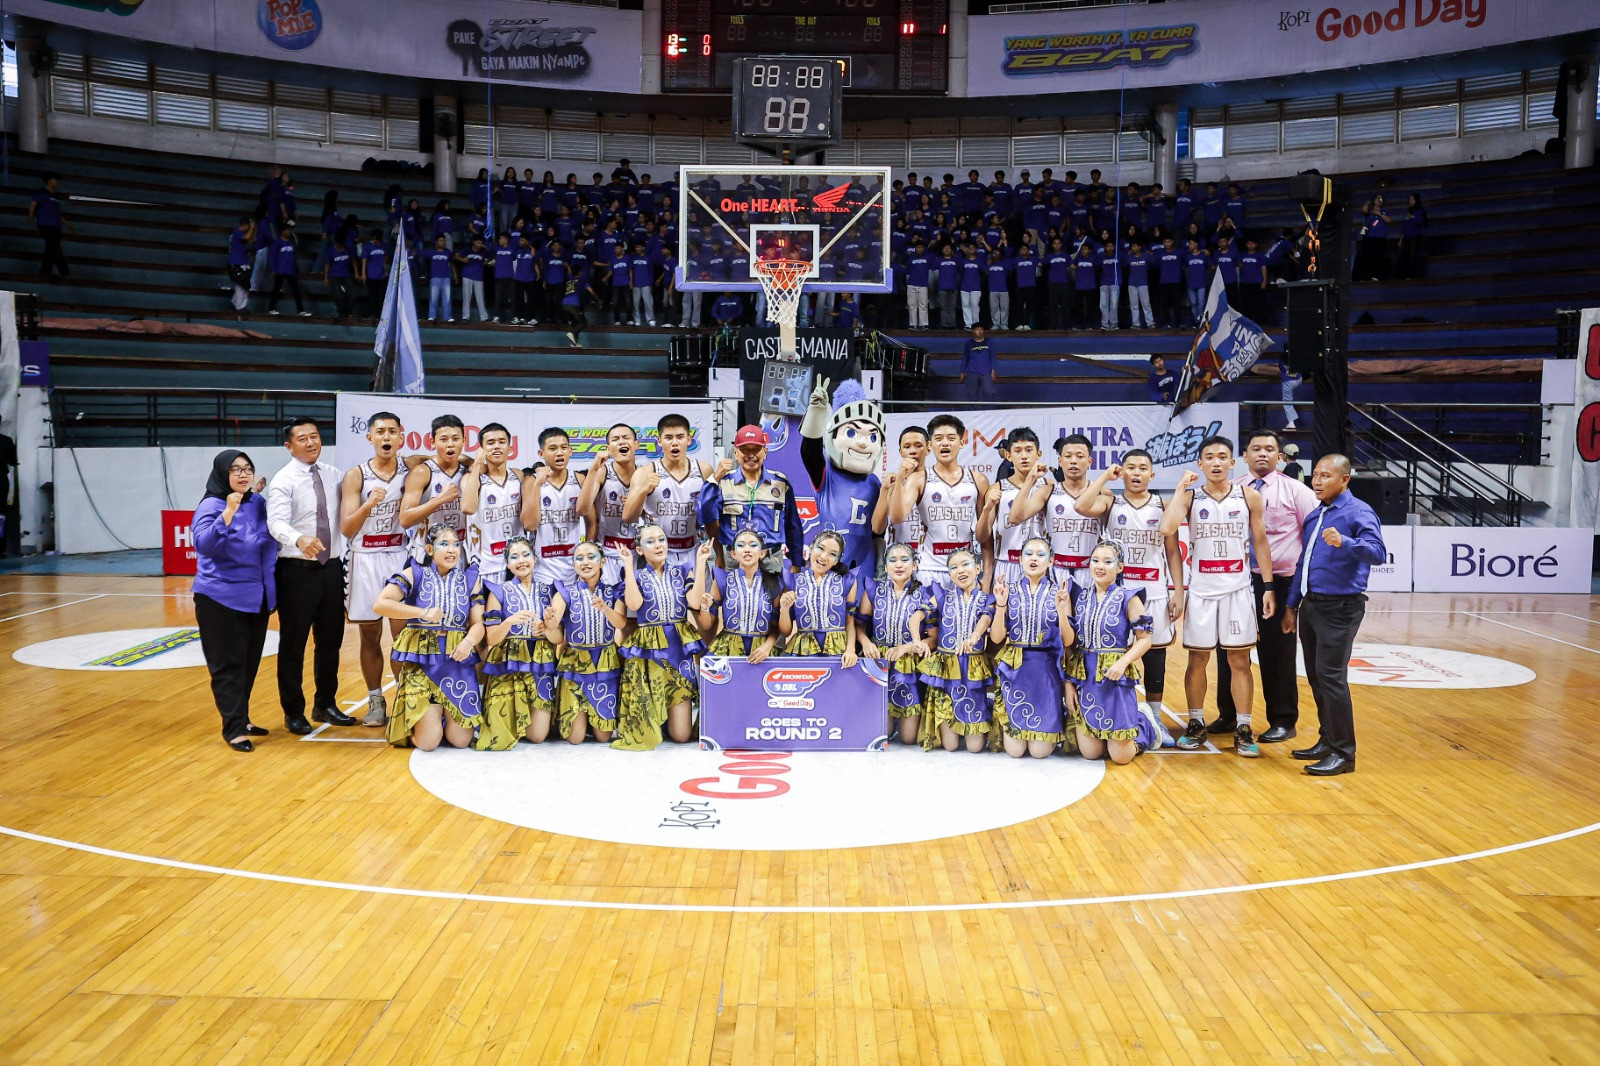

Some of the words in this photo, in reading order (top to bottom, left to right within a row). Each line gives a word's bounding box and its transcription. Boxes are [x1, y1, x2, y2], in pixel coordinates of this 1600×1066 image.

[266, 0, 302, 22] POP
[730, 15, 744, 25] FOULS
[276, 10, 317, 37] MIE
[807, 16, 817, 25] OUT
[866, 16, 881, 26] FOULS
[1278, 8, 1312, 32] Kopi
[1315, 0, 1406, 42] Good
[1414, 0, 1488, 29] Day
[453, 31, 477, 45] PAKE
[479, 26, 598, 52] STREET
[1005, 37, 1047, 50] YANG
[1048, 33, 1105, 47] WORTH
[1129, 30, 1148, 42] YA
[1150, 25, 1195, 40] CUMA
[481, 56, 506, 70] GAYA
[507, 56, 541, 70] MAKIN
[764, 97, 810, 133] 88
[720, 198, 750, 213] One
[744, 336, 849, 361] CASTMANIA
[482, 502, 520, 524] CASTL
[656, 501, 697, 517] CASTL
[848, 496, 869, 525] C
[670, 519, 688, 536] 16
[947, 524, 959, 541] 8
[1052, 517, 1100, 536] CASTLE
[1195, 521, 1244, 540] CASTLE
[1068, 536, 1080, 553] 4
[1213, 540, 1228, 558] 11
[1127, 547, 1147, 565] 17
[1450, 543, 1559, 578] Bioré
[1230, 620, 1241, 635] 11
[760, 717, 801, 727] GOES
[805, 717, 828, 727] TO
[744, 727, 822, 741] ROUND
[828, 727, 843, 740] 2
[679, 749, 793, 799] Goo
